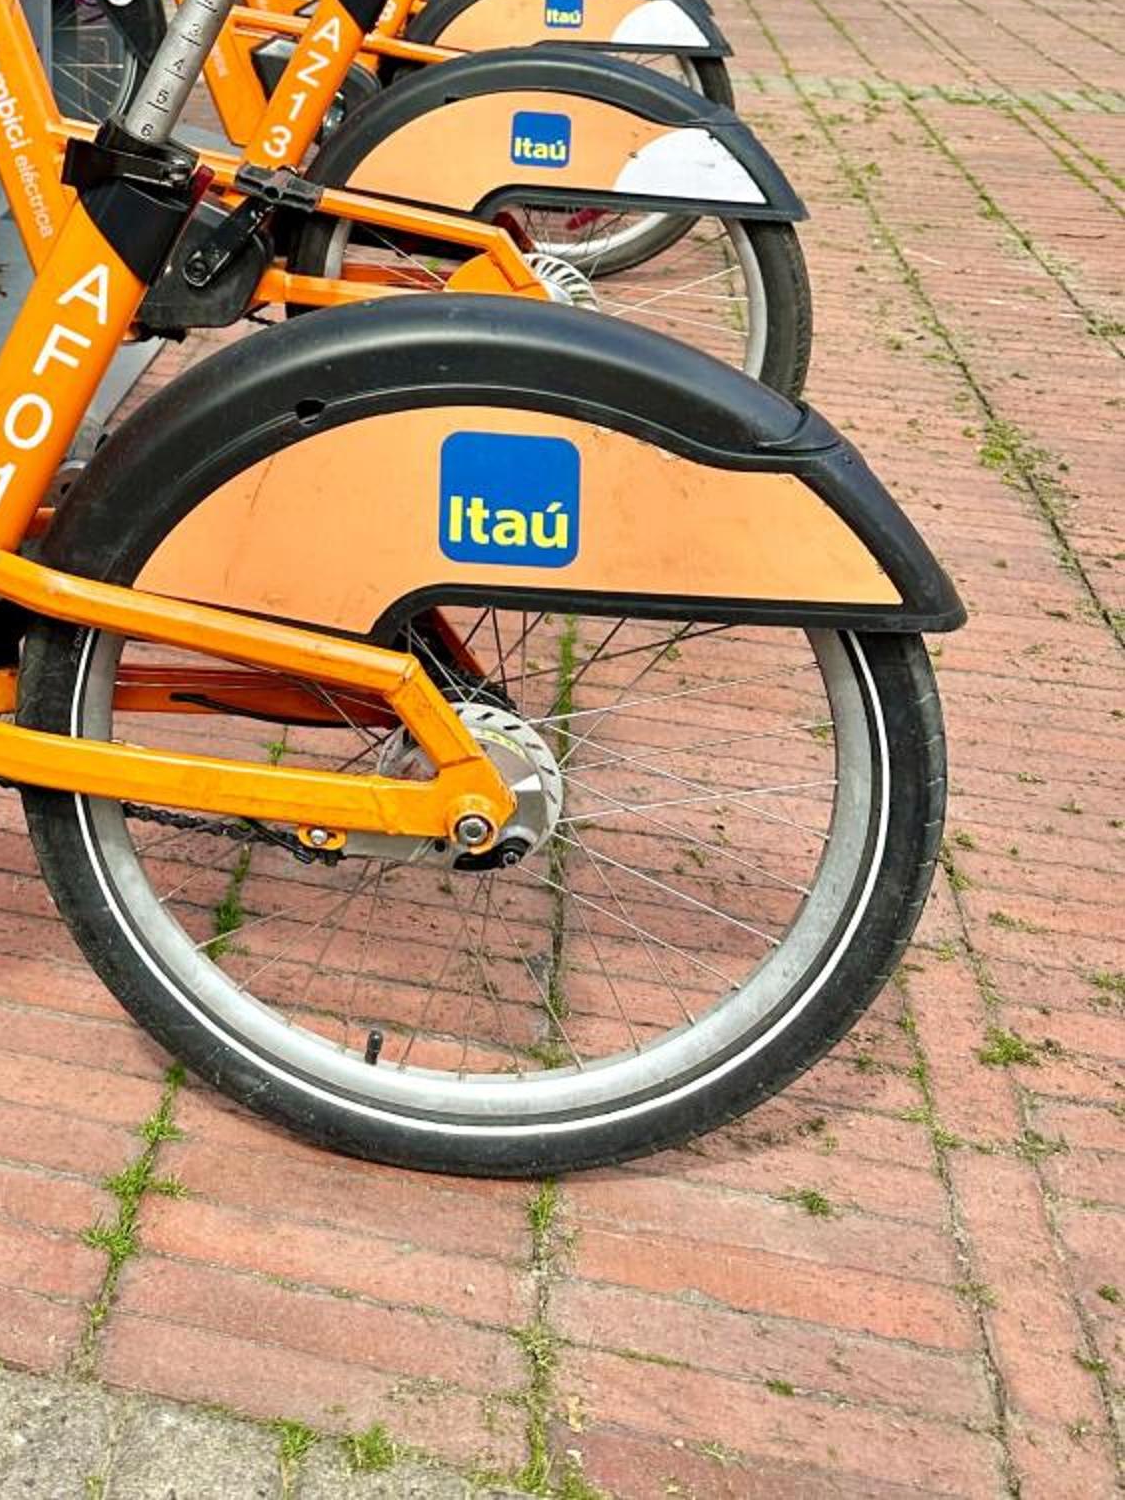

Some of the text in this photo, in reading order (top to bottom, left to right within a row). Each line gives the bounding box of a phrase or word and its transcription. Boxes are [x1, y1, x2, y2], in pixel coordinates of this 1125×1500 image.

[546, 9, 581, 24] Itaú
[189, 23, 202, 37] 3
[141, 123, 154, 139] 6
[514, 137, 567, 162] Itaú
[448, 495, 569, 549] Itaú
